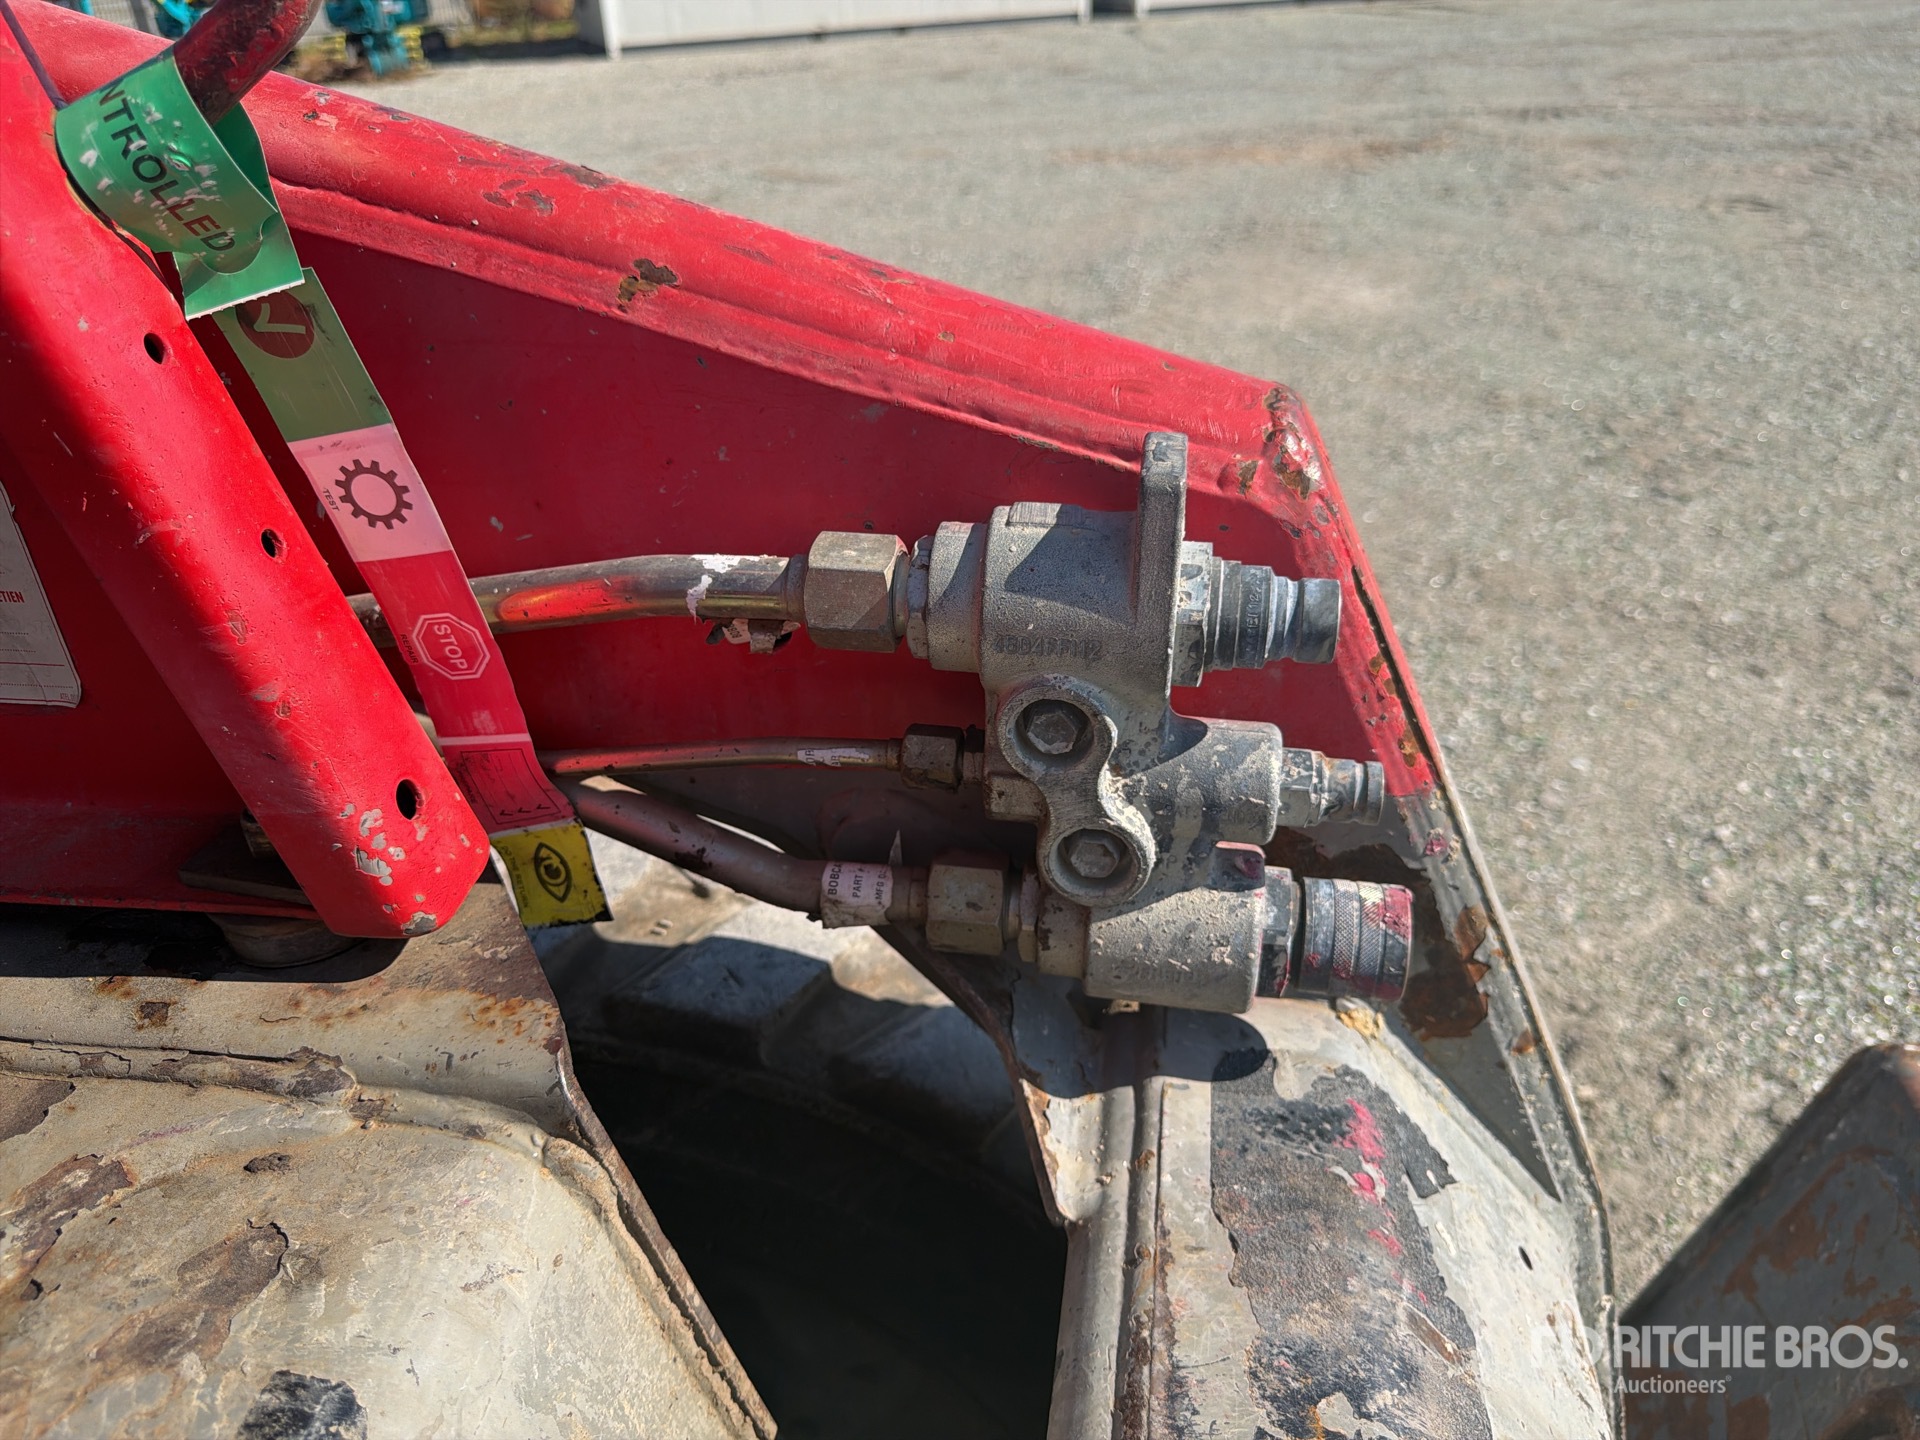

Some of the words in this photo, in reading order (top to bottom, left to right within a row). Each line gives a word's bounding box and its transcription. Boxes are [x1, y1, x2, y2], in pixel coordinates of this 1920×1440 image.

[322, 488, 340, 512] TEST
[400, 633, 420, 664] REPAIR
[434, 623, 468, 670] STOP
[852, 874, 864, 898] PART
[875, 881, 884, 900] MFG
